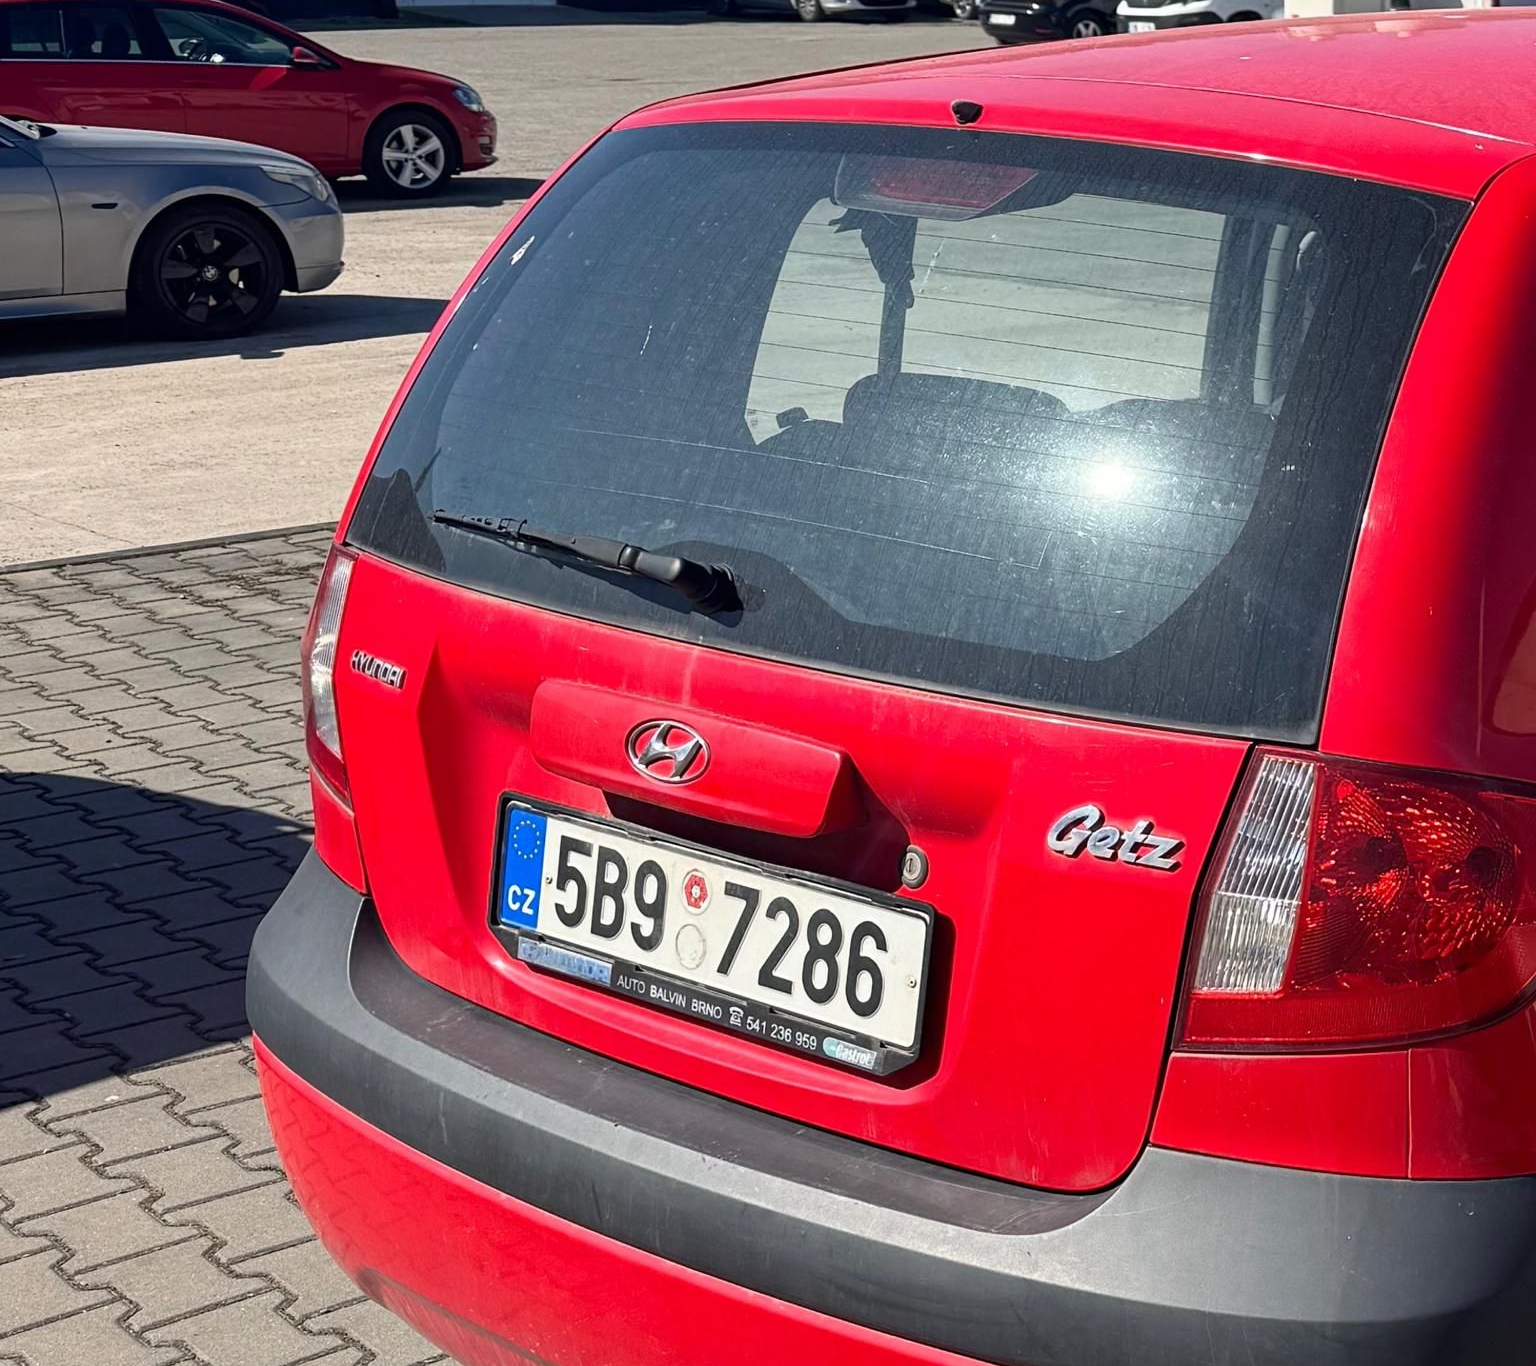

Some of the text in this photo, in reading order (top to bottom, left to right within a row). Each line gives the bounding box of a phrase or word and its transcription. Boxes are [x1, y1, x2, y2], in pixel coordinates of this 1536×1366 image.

[352, 650, 407, 690] HYUNDAI
[1047, 803, 1185, 872] Getz
[507, 884, 536, 916] CZ
[554, 834, 889, 1019] 5B9 7286
[616, 974, 817, 1051] AUTO BALVIN BRNO 541 236 959
[835, 1043, 875, 1067] Castrol
